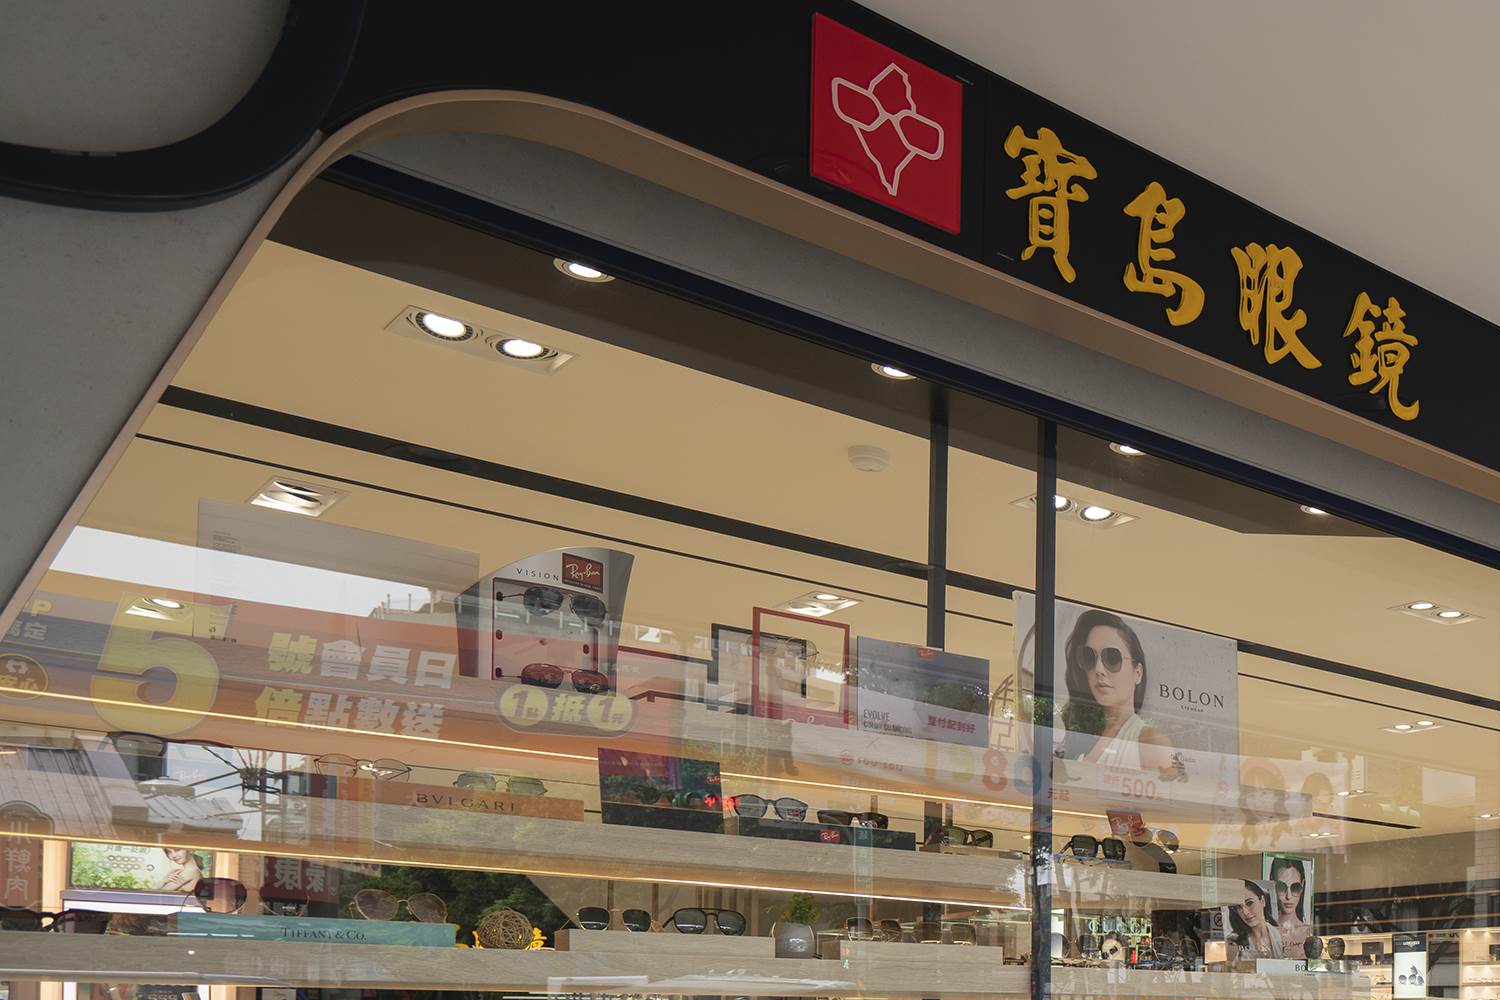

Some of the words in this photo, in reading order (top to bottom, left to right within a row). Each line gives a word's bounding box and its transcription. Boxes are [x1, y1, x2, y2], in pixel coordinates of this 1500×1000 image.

[1004, 126, 1420, 421] 寶島眼鏡
[516, 567, 560, 582] VISION
[1160, 684, 1224, 709] BOLON
[863, 708, 890, 722] EVOLVE
